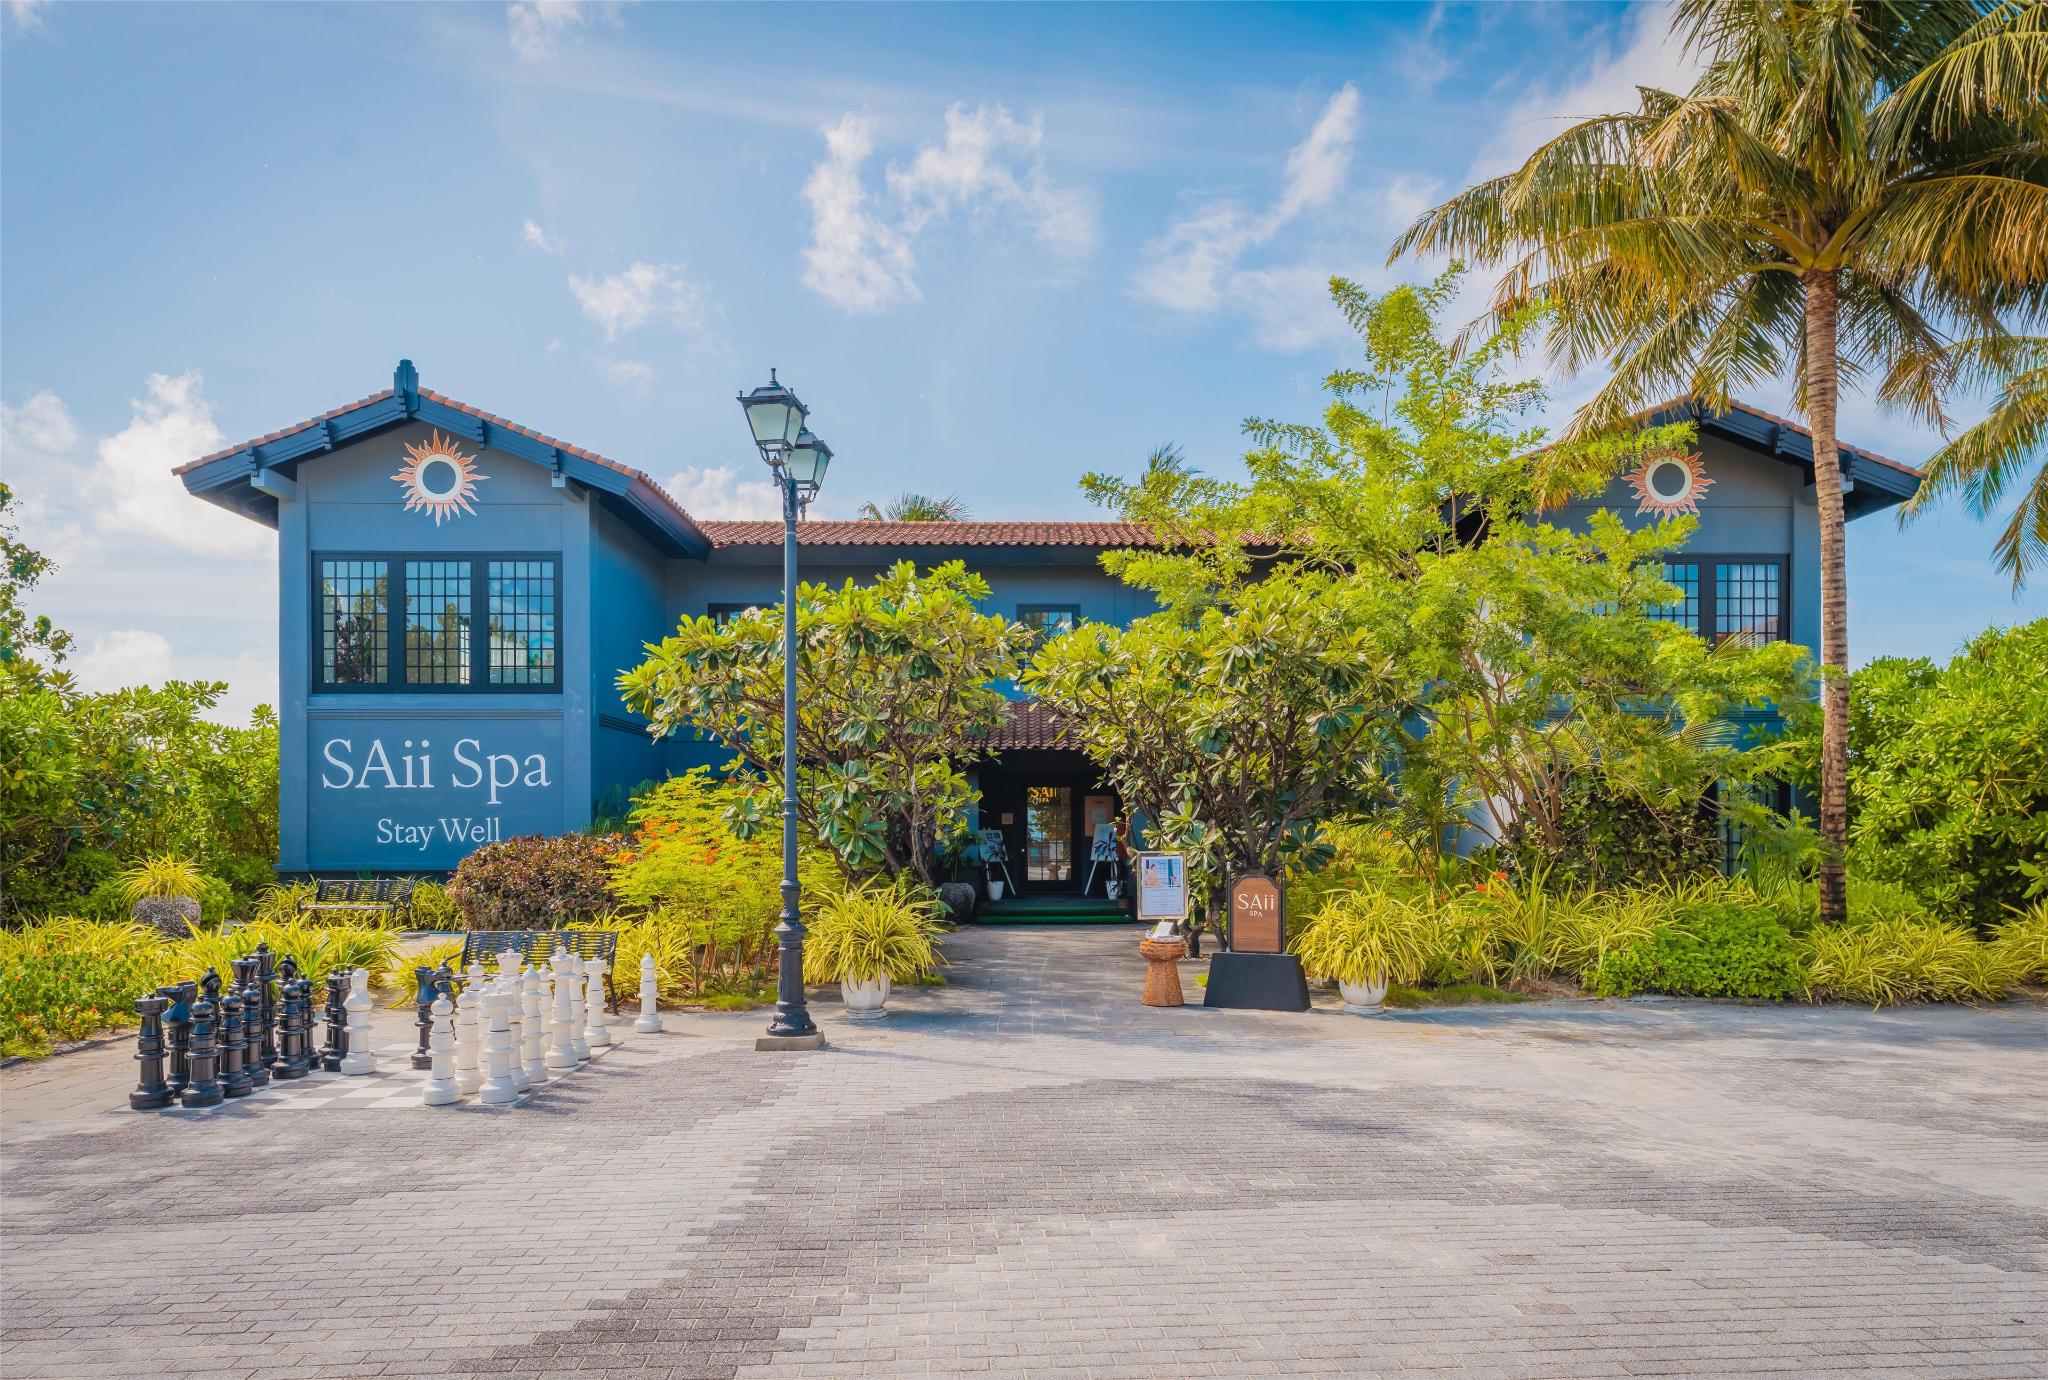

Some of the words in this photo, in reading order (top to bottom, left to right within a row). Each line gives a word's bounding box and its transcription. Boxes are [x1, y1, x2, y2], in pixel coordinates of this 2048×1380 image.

[322, 738, 435, 789] SAii
[452, 738, 552, 805] Spa
[376, 818, 435, 851] Stay
[438, 817, 501, 844] Well
[1238, 893, 1275, 910] SAii
